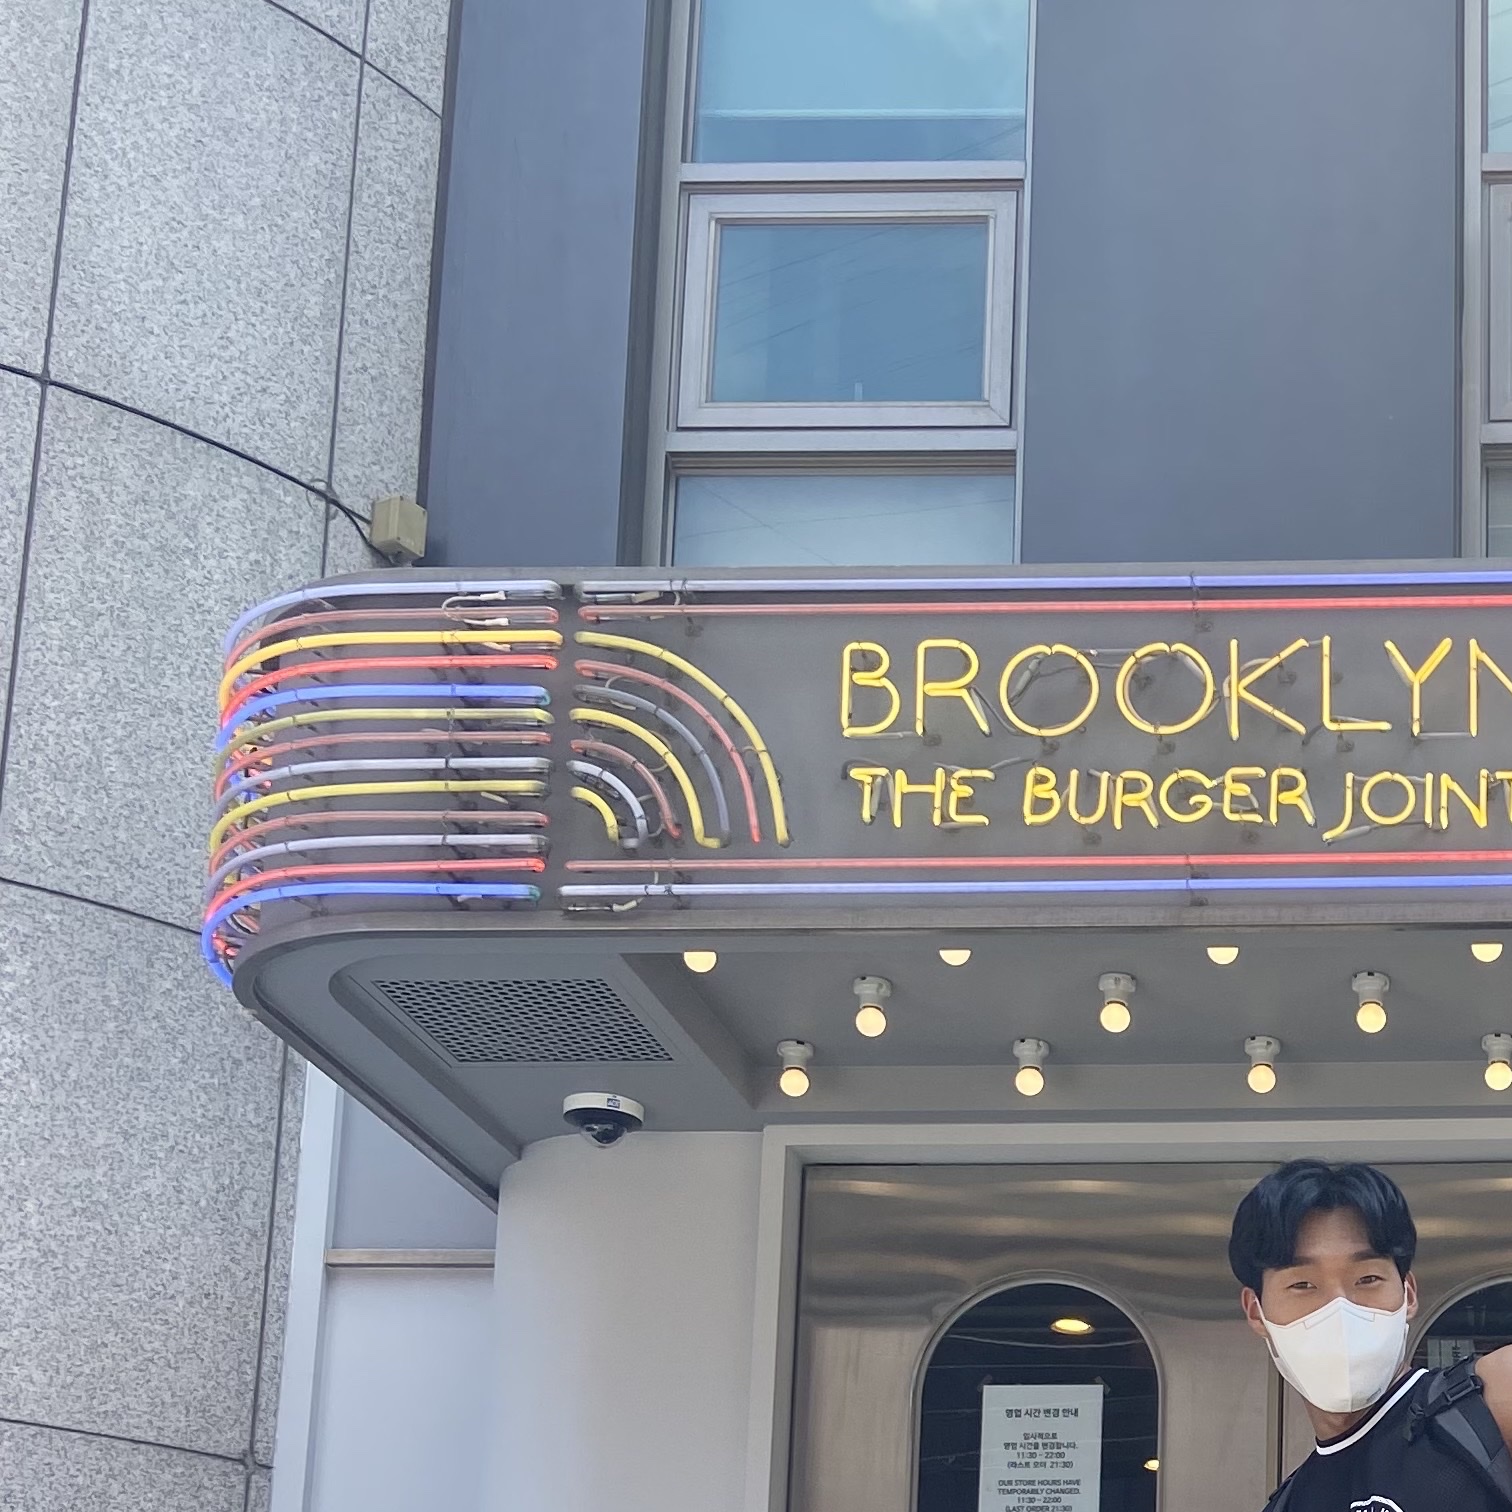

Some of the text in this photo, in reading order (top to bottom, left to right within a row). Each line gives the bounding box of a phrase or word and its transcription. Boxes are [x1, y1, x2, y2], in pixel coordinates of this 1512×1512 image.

[848, 765, 994, 828] THE
[1022, 764, 1316, 829] BURGER
[1005, 1408, 1079, 1418] 영업 시간 변경 안내
